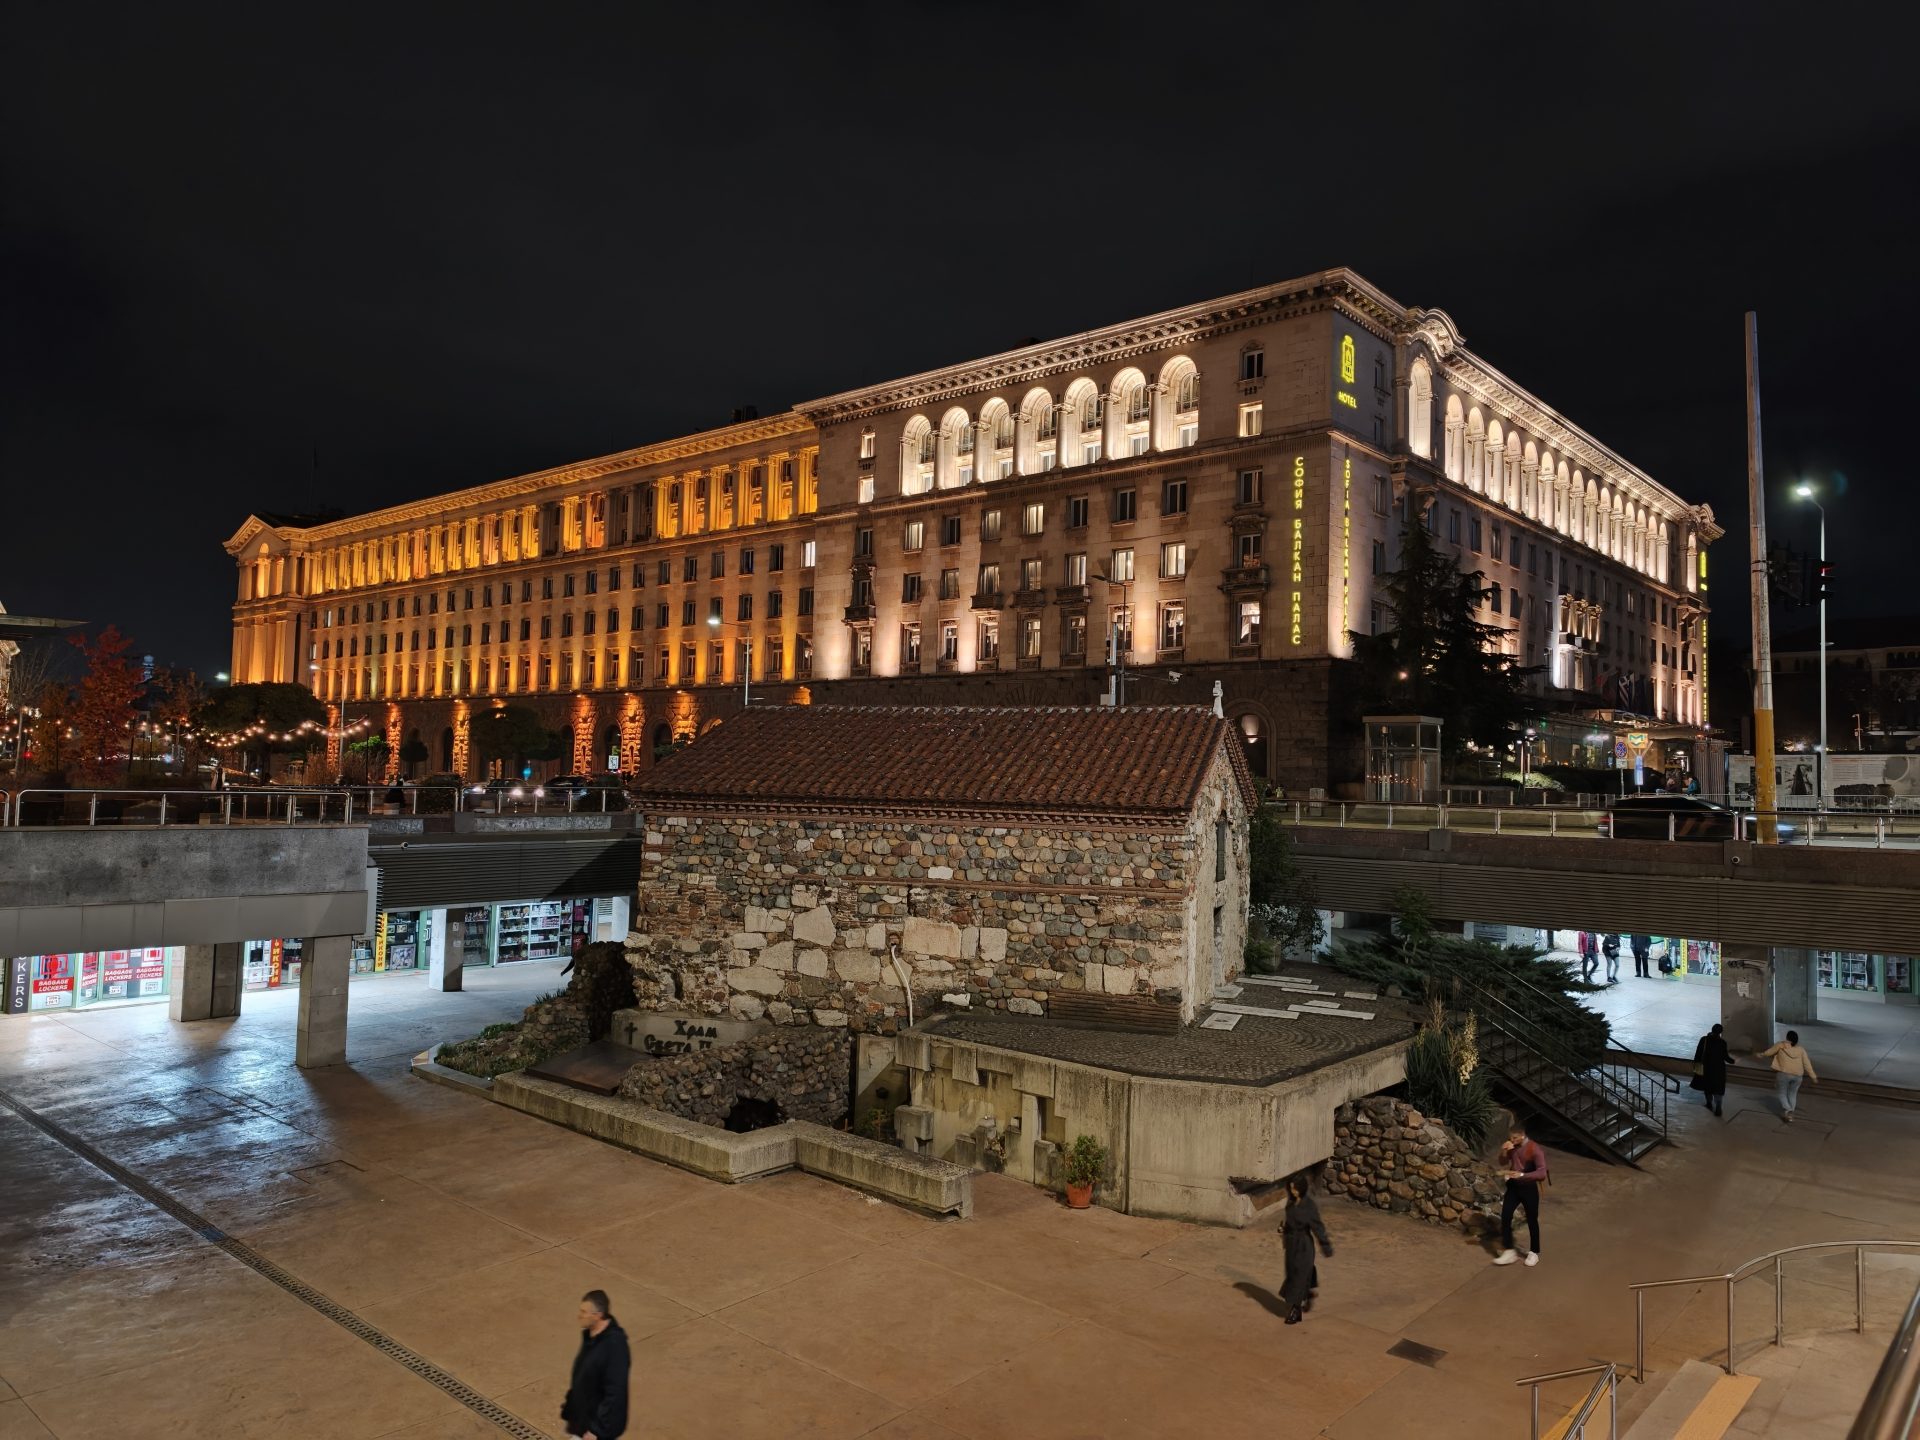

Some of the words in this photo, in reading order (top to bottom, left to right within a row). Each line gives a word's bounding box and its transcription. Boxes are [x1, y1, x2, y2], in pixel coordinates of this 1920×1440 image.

[1338, 391, 1357, 408] HOTEL
[1294, 456, 1304, 509] СОФИЯ
[1292, 519, 1303, 582] БАЛКАН
[1292, 592, 1302, 645] ПАЛАС
[104, 974, 132, 982] LOCKERS
[136, 966, 164, 974] BAGGAGE
[14, 956, 26, 1007] KERS
[38, 978, 69, 987] BAGGAGE
[38, 984, 68, 992] LOCKERS
